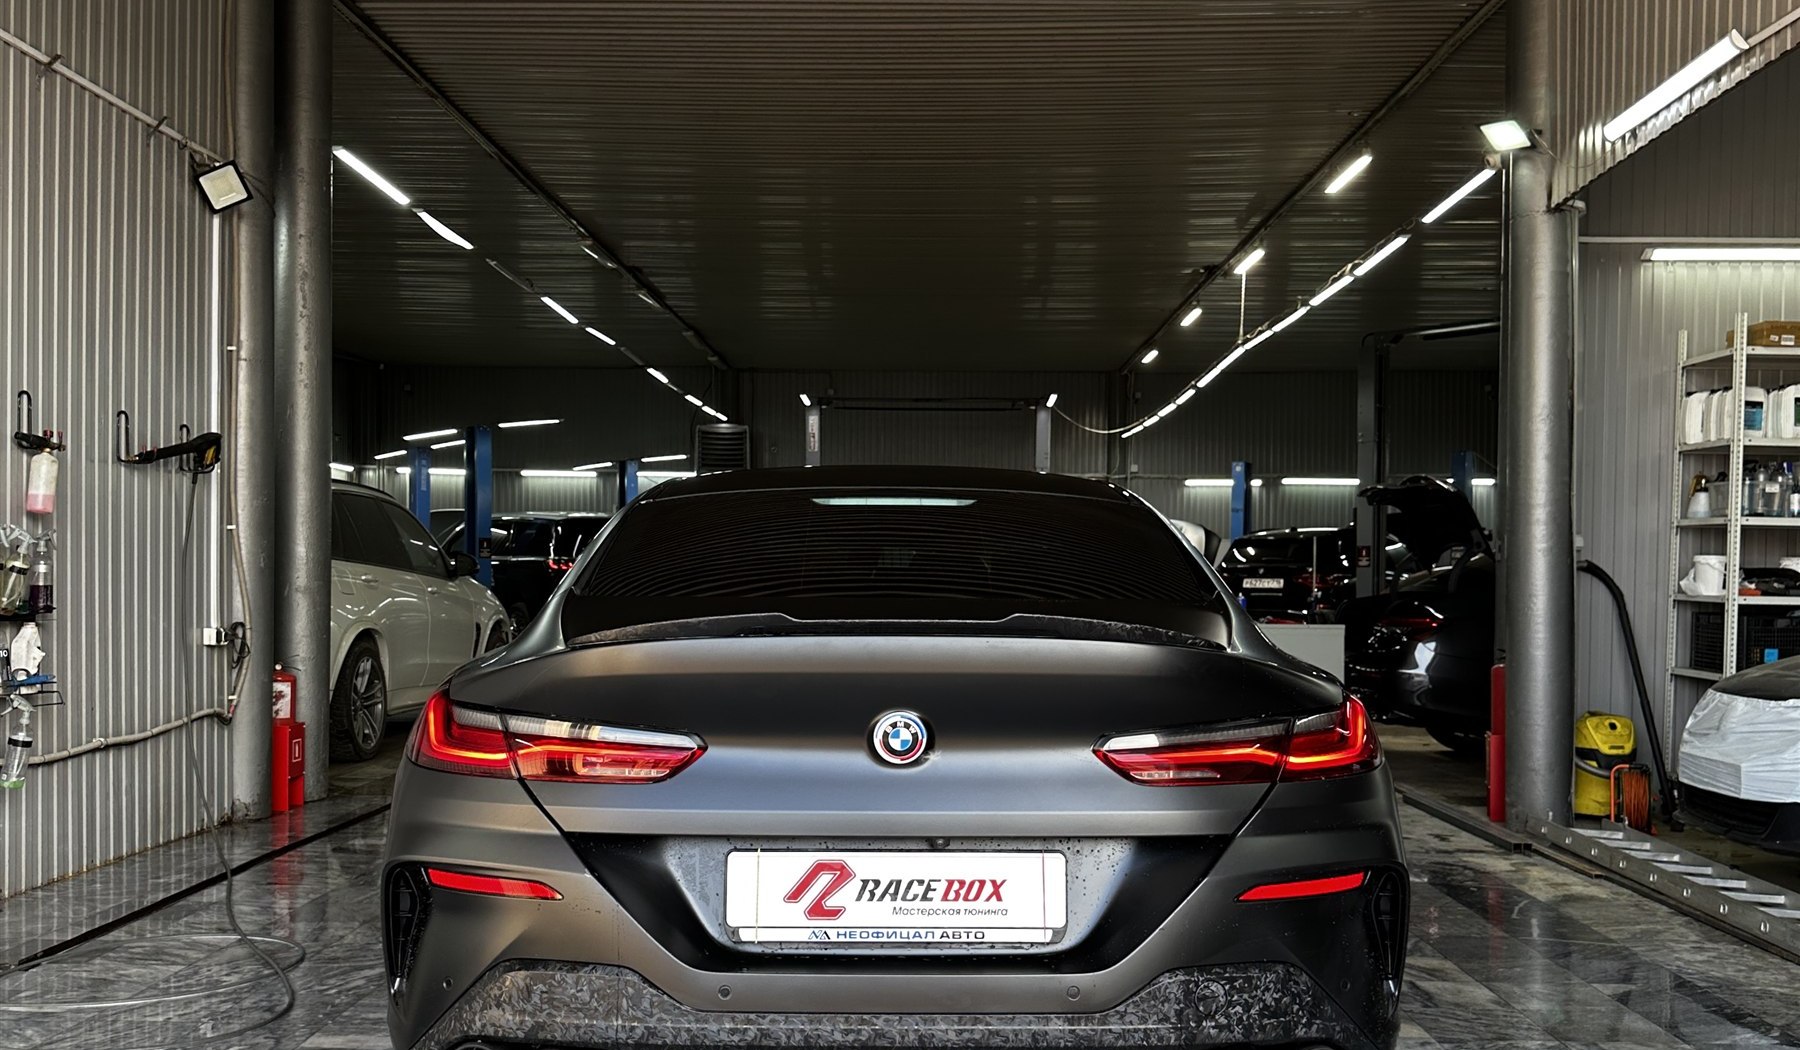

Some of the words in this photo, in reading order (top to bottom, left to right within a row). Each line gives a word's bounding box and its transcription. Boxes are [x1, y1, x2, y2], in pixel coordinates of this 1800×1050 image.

[885, 721, 917, 734] BMW
[892, 906, 960, 917] Мастерская
[963, 908, 1008, 916] тюнинга
[836, 930, 935, 940] НЕОФИЦАЛ
[939, 930, 985, 940] АВТО
